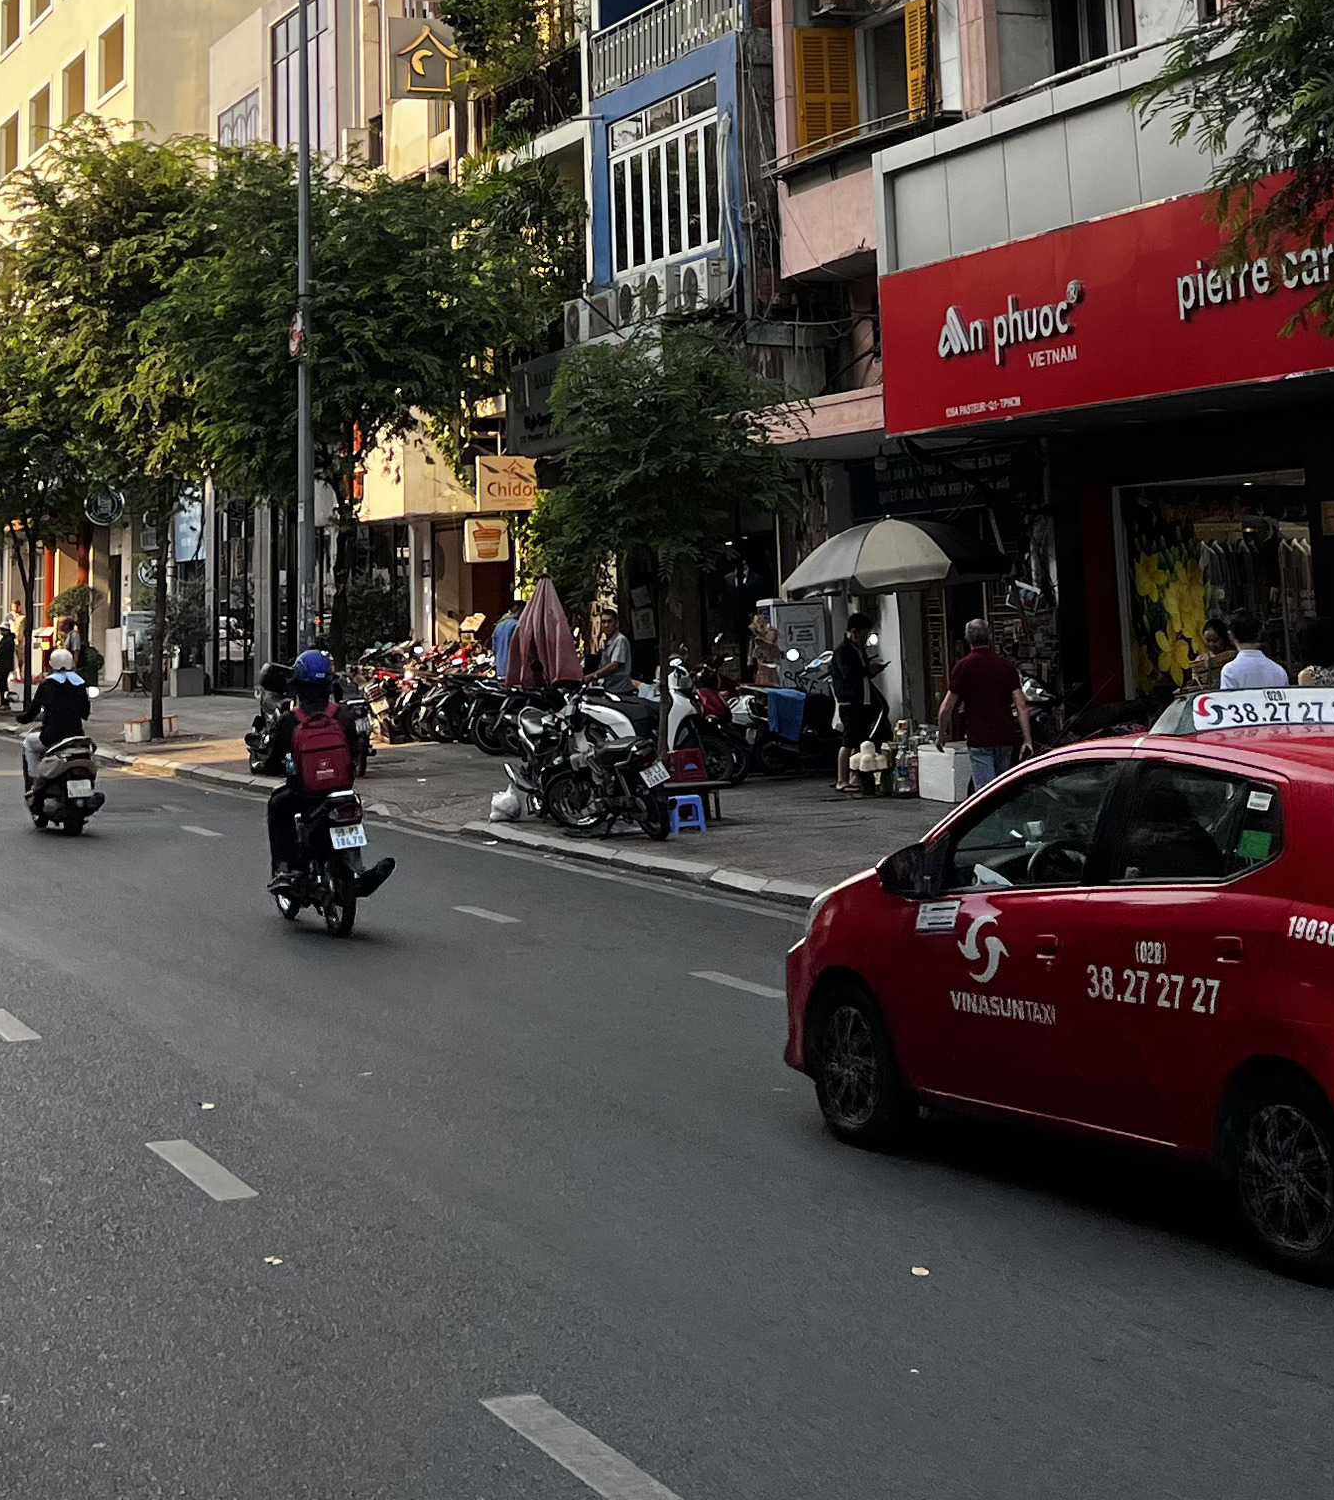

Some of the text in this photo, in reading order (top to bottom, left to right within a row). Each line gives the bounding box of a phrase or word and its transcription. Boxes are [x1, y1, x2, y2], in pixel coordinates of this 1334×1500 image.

[1177, 258, 1270, 320] pierre
[1028, 345, 1078, 368] VIETNAM
[487, 480, 537, 498] Chidor
[1227, 702, 1291, 724] 38.27
[1297, 702, 1324, 723] 27
[1086, 964, 1221, 1015] 38.27 27 27
